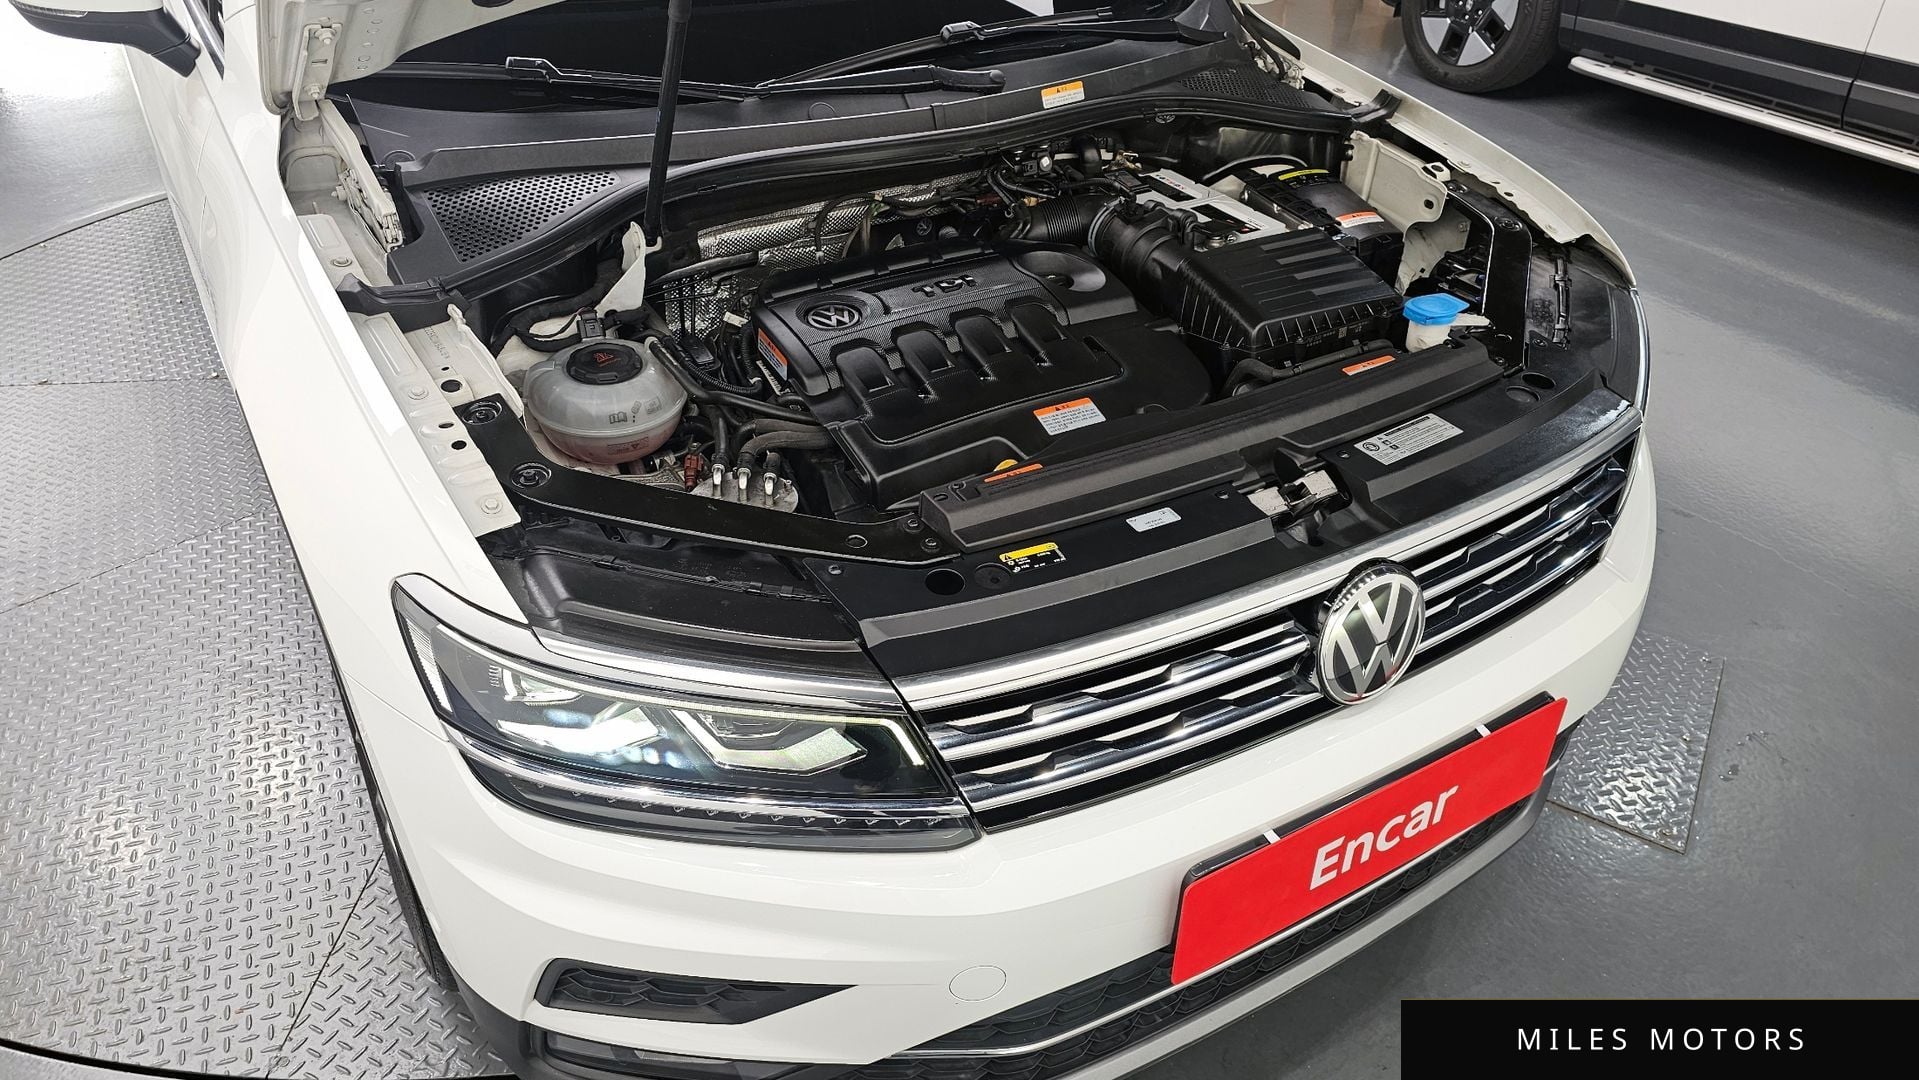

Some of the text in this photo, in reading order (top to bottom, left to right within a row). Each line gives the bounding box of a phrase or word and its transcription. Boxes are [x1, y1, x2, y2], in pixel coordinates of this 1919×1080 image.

[807, 302, 859, 329] VW
[913, 274, 976, 297] TDI
[1321, 573, 1424, 704] VW
[1309, 784, 1459, 891] Encar
